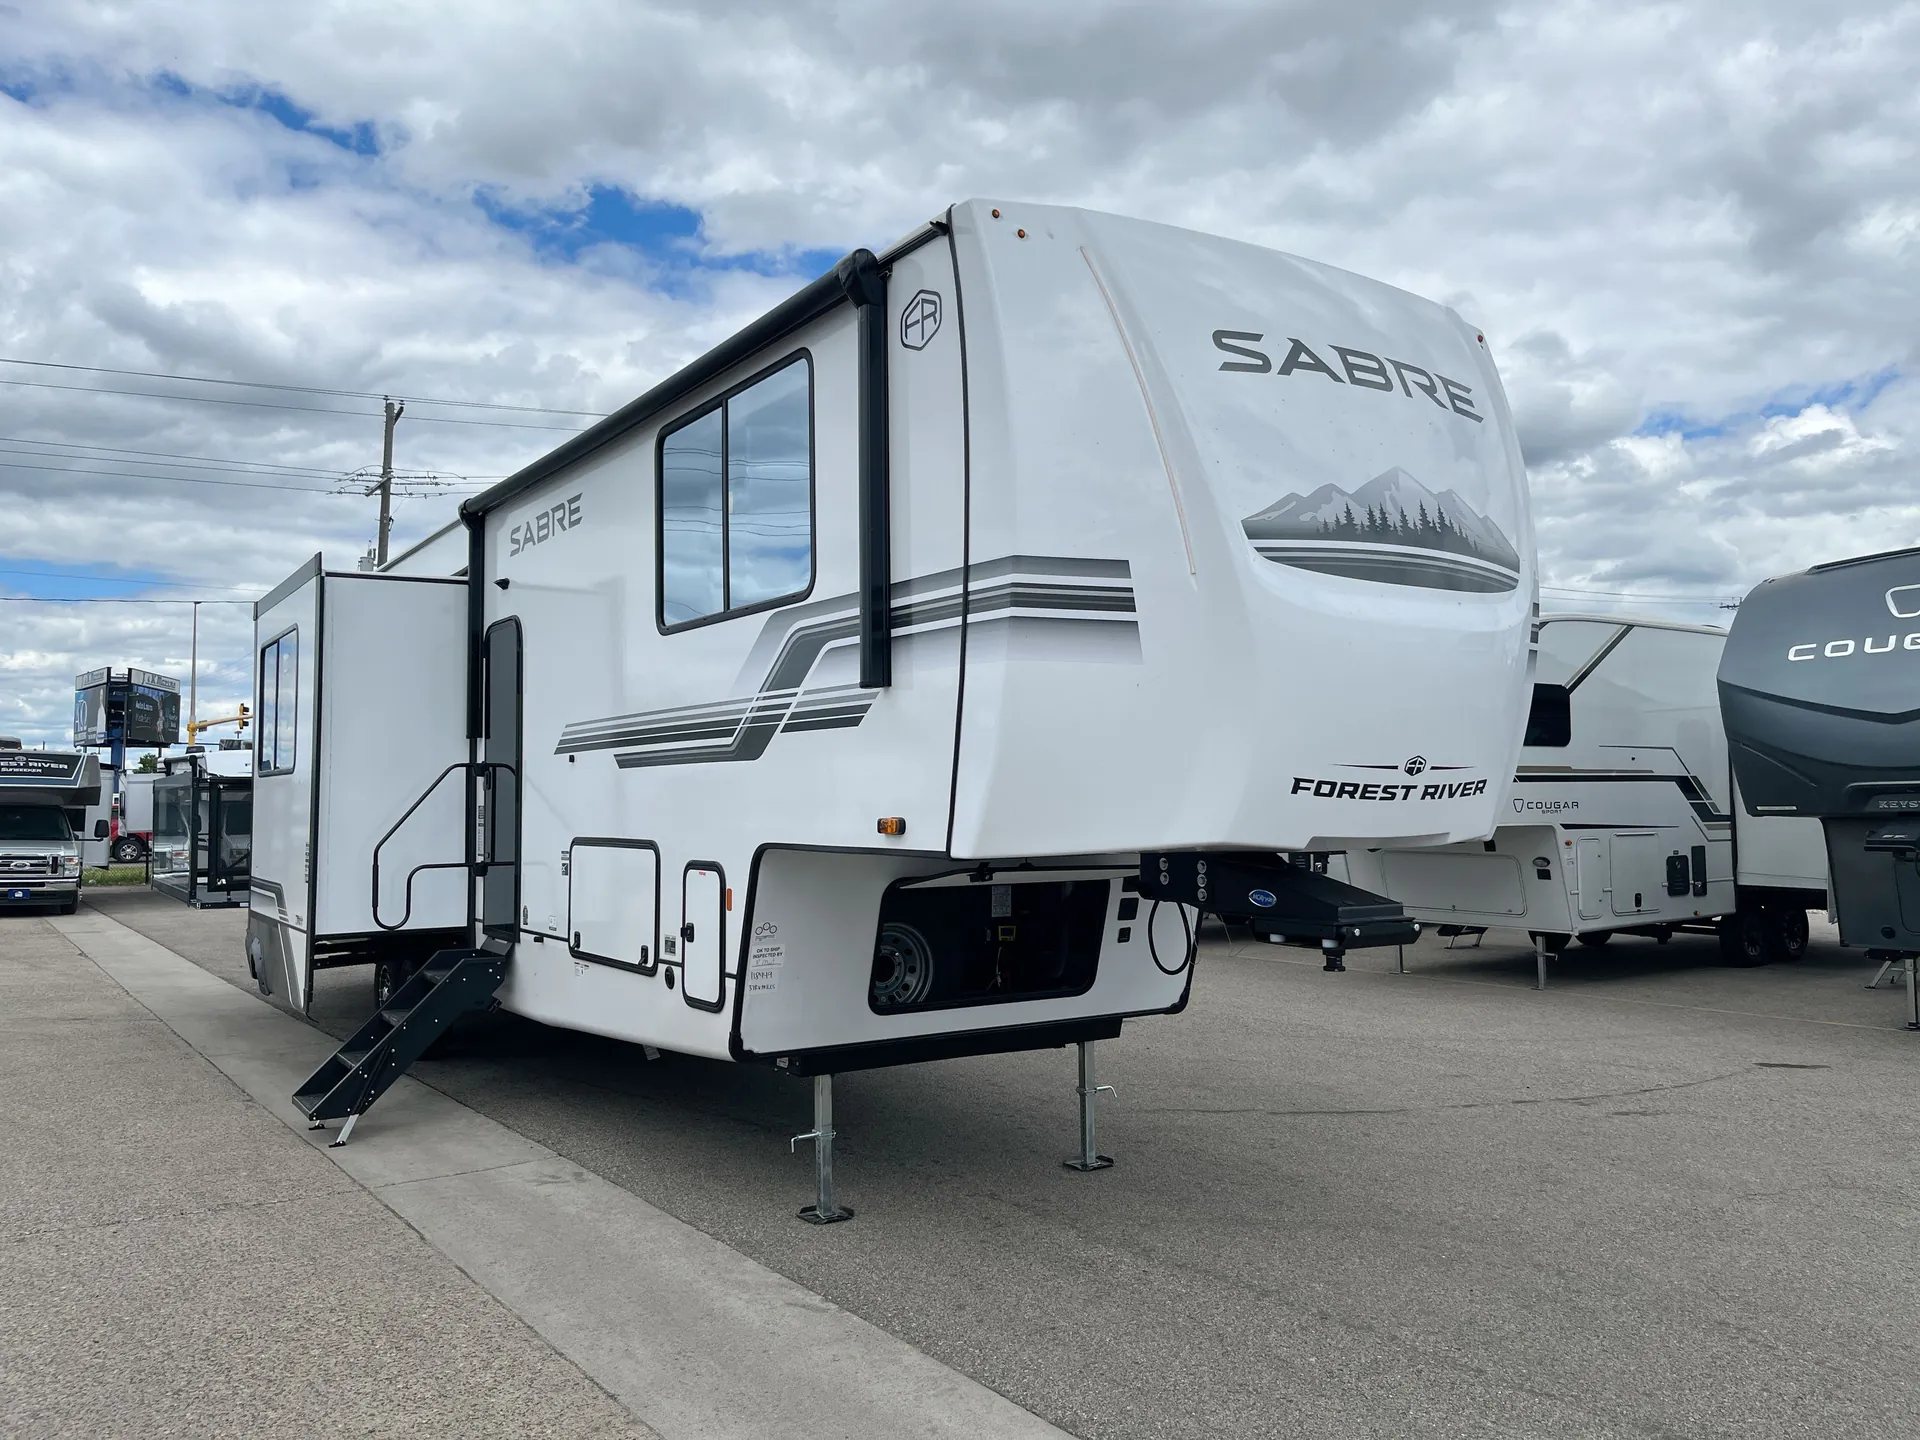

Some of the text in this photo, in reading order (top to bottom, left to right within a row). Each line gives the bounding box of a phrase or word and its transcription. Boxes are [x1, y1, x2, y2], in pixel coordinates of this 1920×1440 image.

[1212, 329, 1484, 424] SABRE
[509, 492, 583, 557] SABRE
[28, 761, 68, 769] RIVER
[1290, 777, 1488, 801] FOREST RIVER
[1526, 801, 1579, 810] COUGAR
[1878, 800, 1920, 808] KEYS
